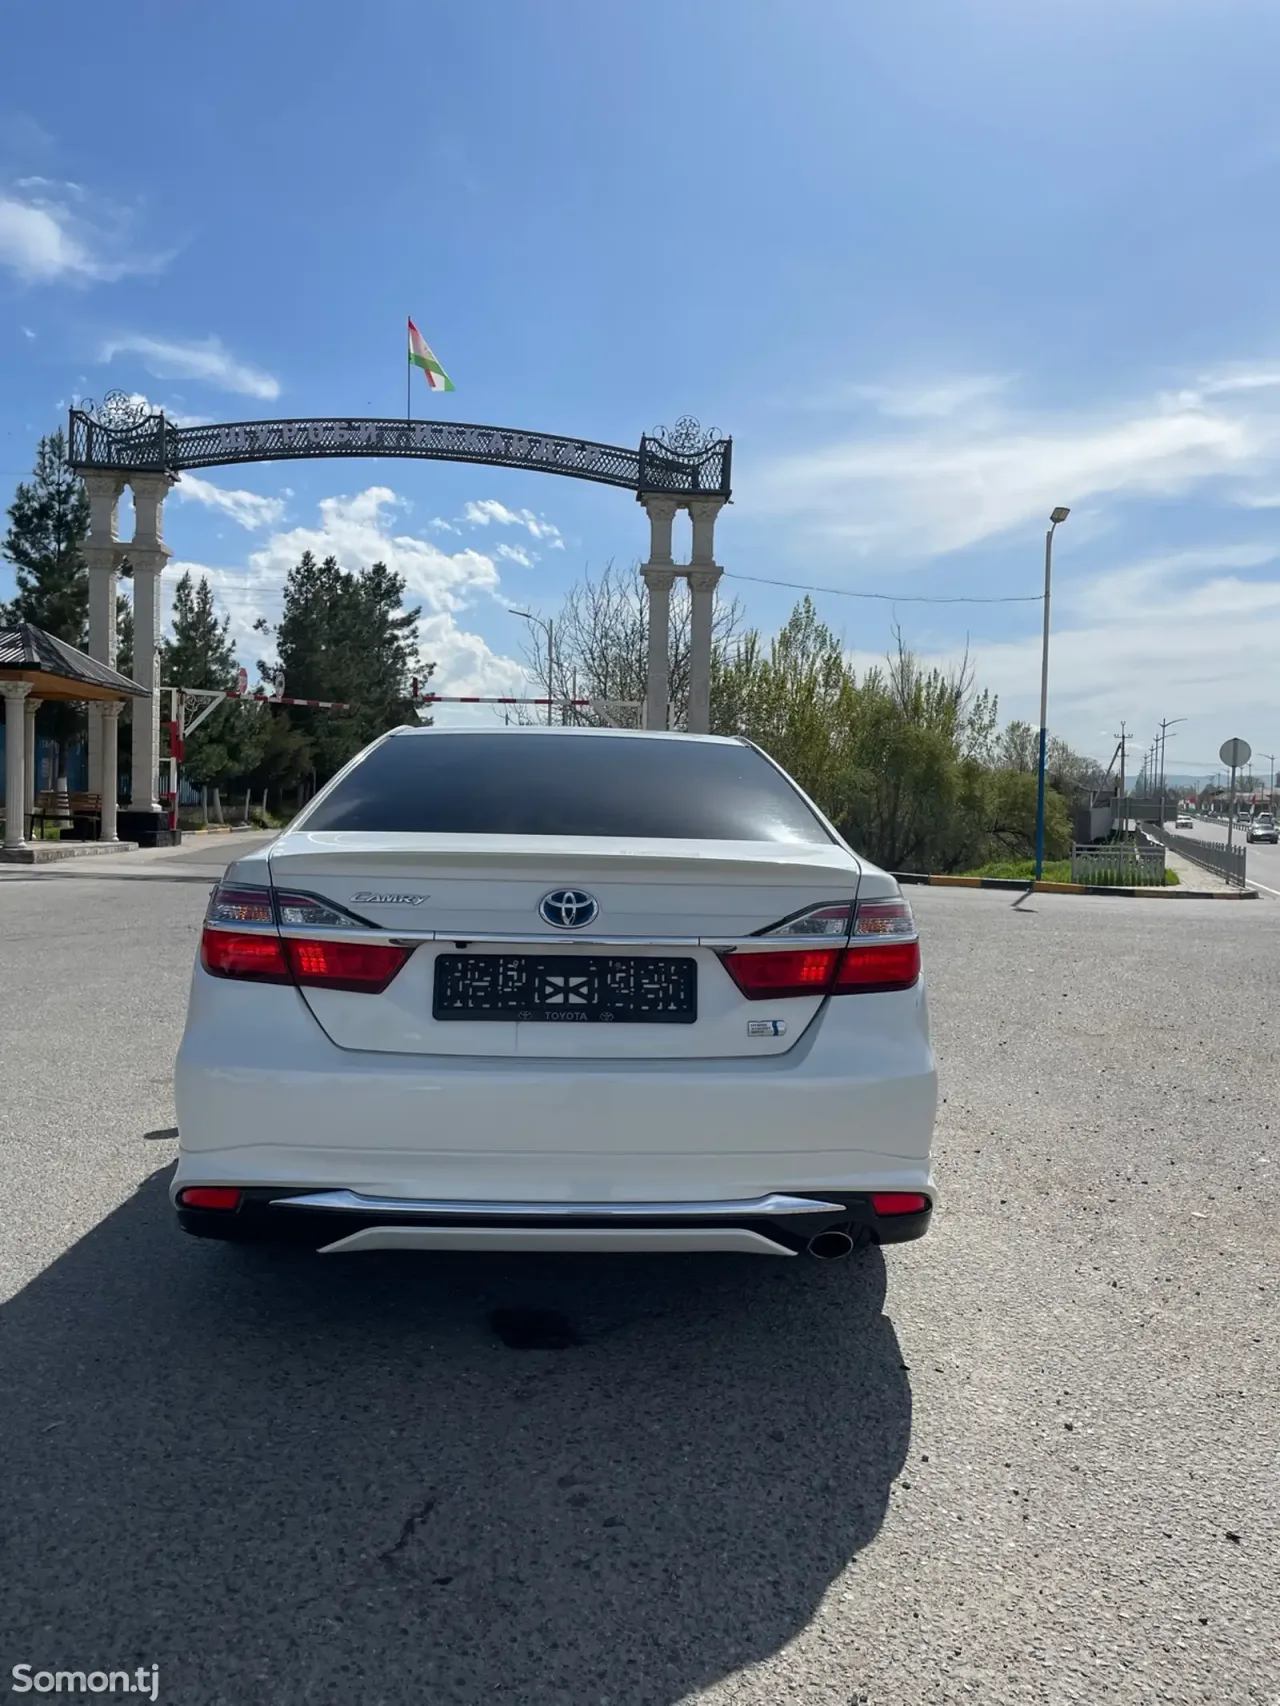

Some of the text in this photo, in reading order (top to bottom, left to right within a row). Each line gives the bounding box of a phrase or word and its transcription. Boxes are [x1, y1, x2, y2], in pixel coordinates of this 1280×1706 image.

[414, 424, 601, 466] ИСКАНДАР
[350, 891, 431, 906] CAMRY
[544, 1011, 588, 1020] TOYOTA
